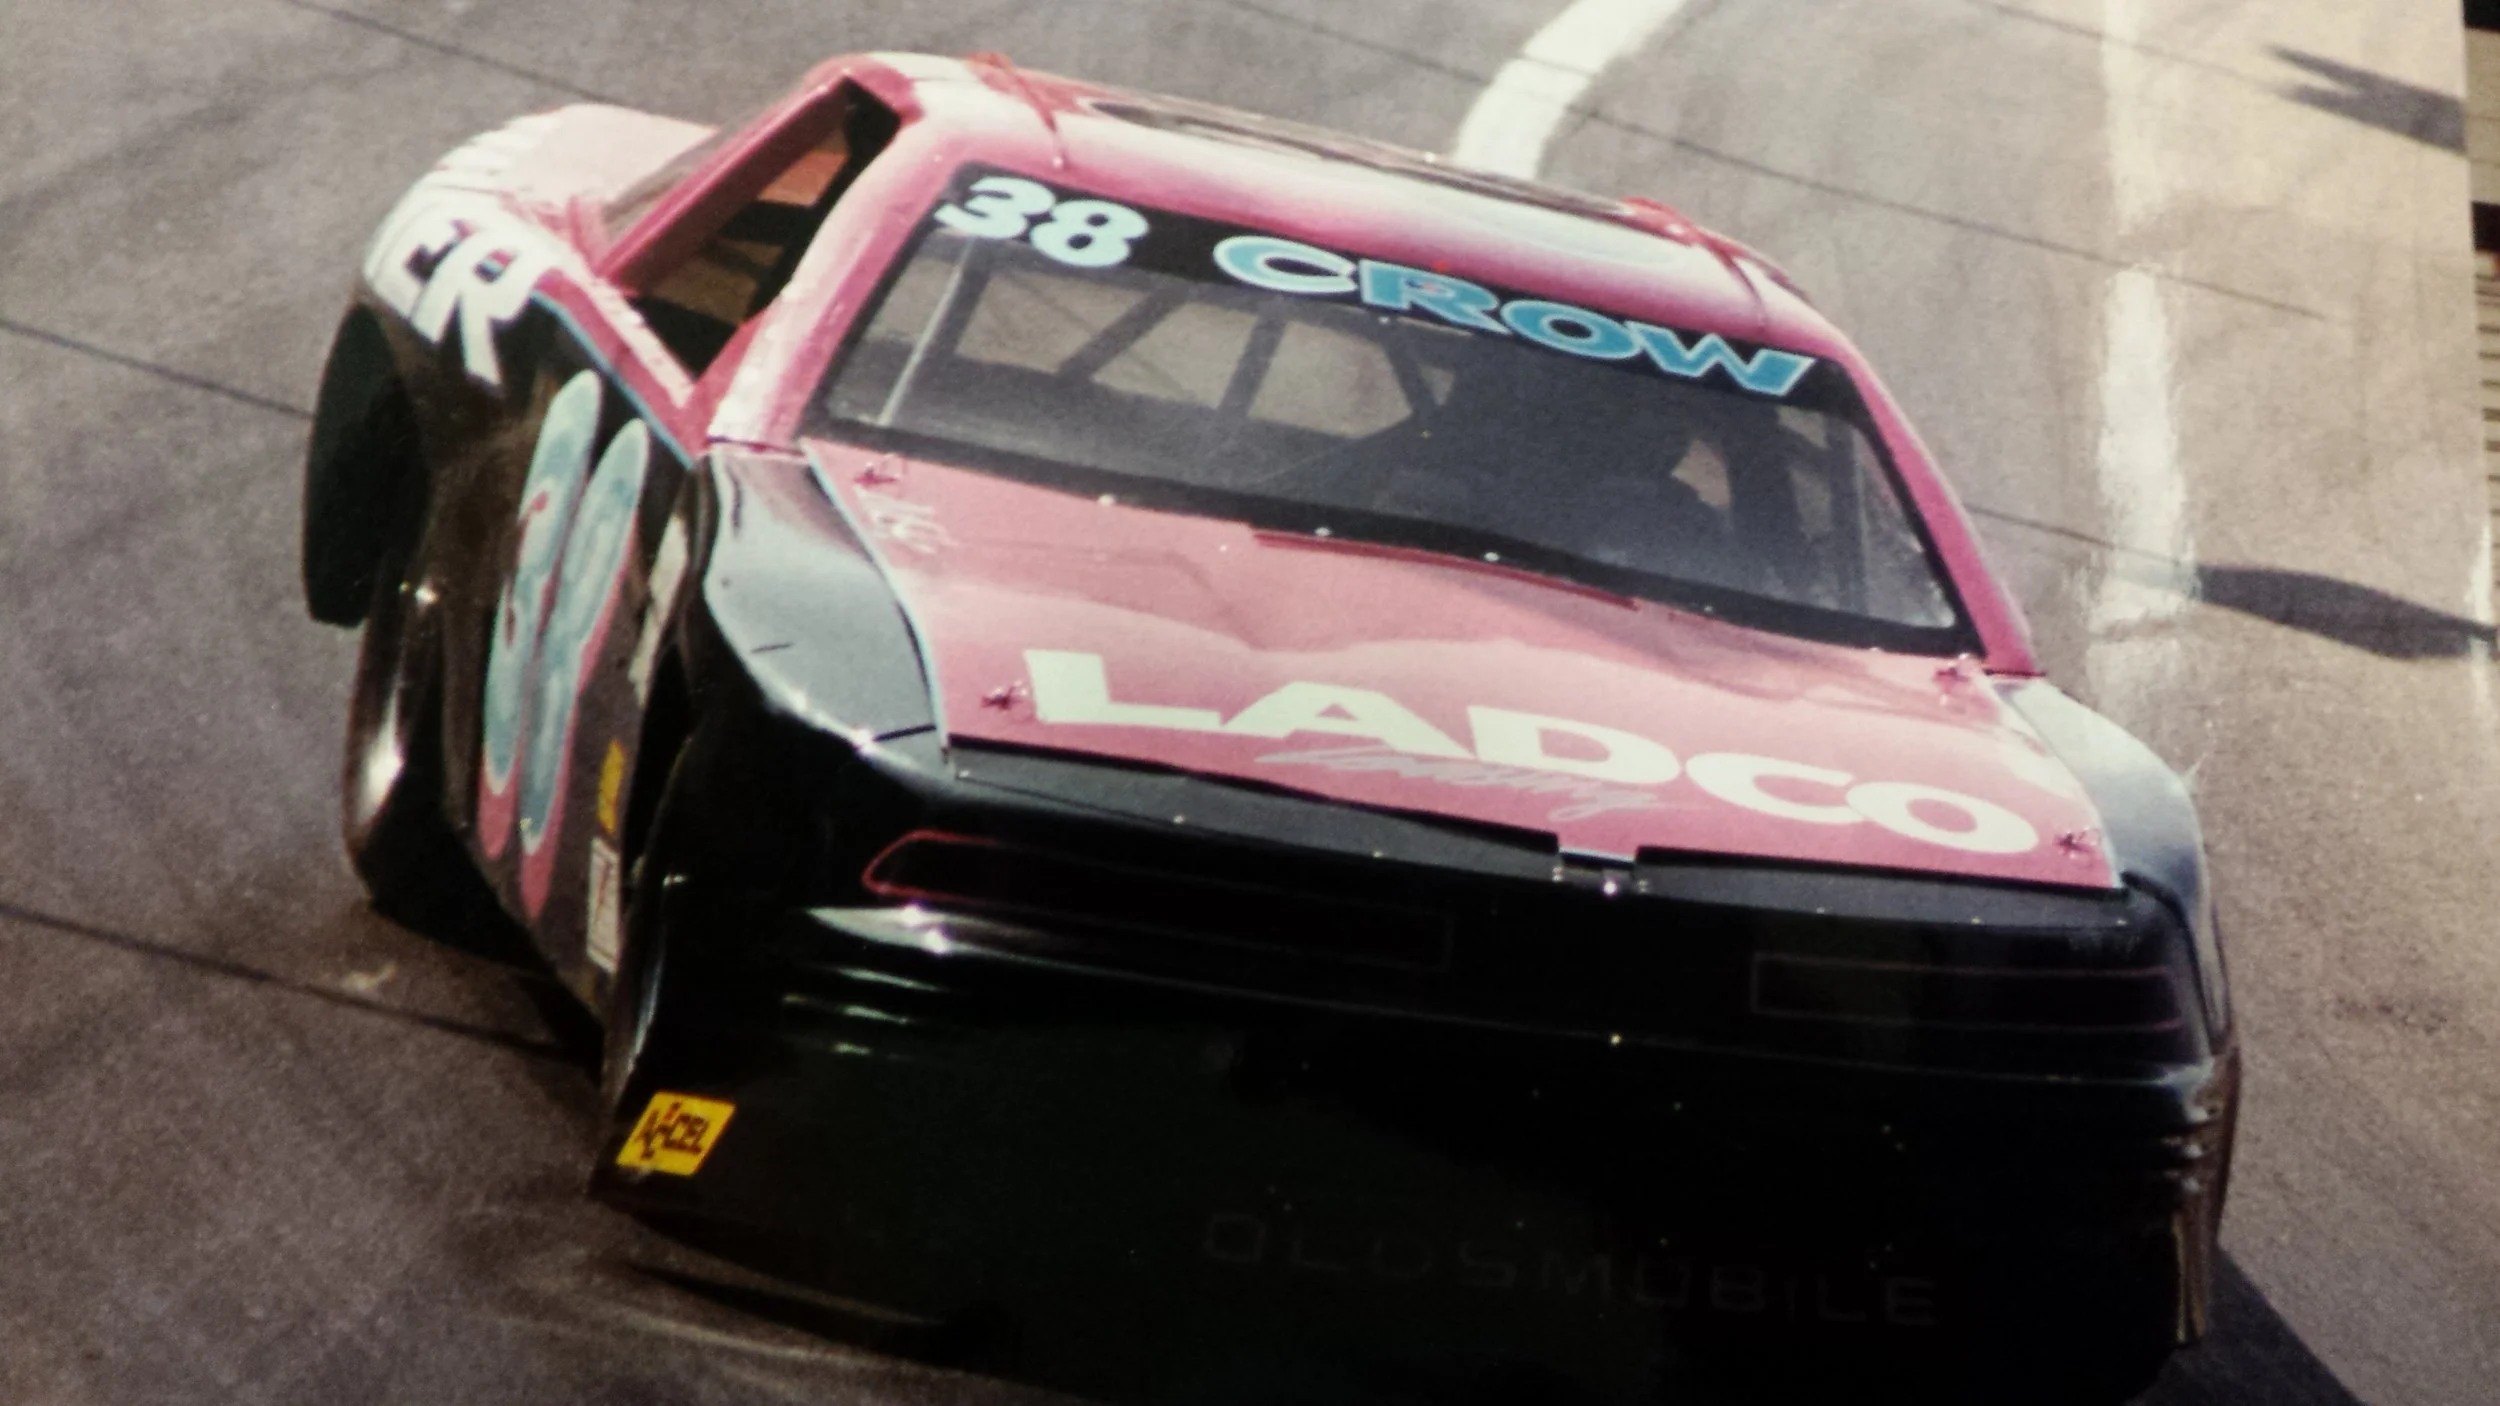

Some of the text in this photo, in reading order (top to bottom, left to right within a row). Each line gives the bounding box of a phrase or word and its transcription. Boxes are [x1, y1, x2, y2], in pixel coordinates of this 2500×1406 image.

[934, 176, 1815, 398] 38 CROW
[1024, 648, 2039, 855] LADCO
[1203, 1211, 1941, 1329] OLDSMOBILE
